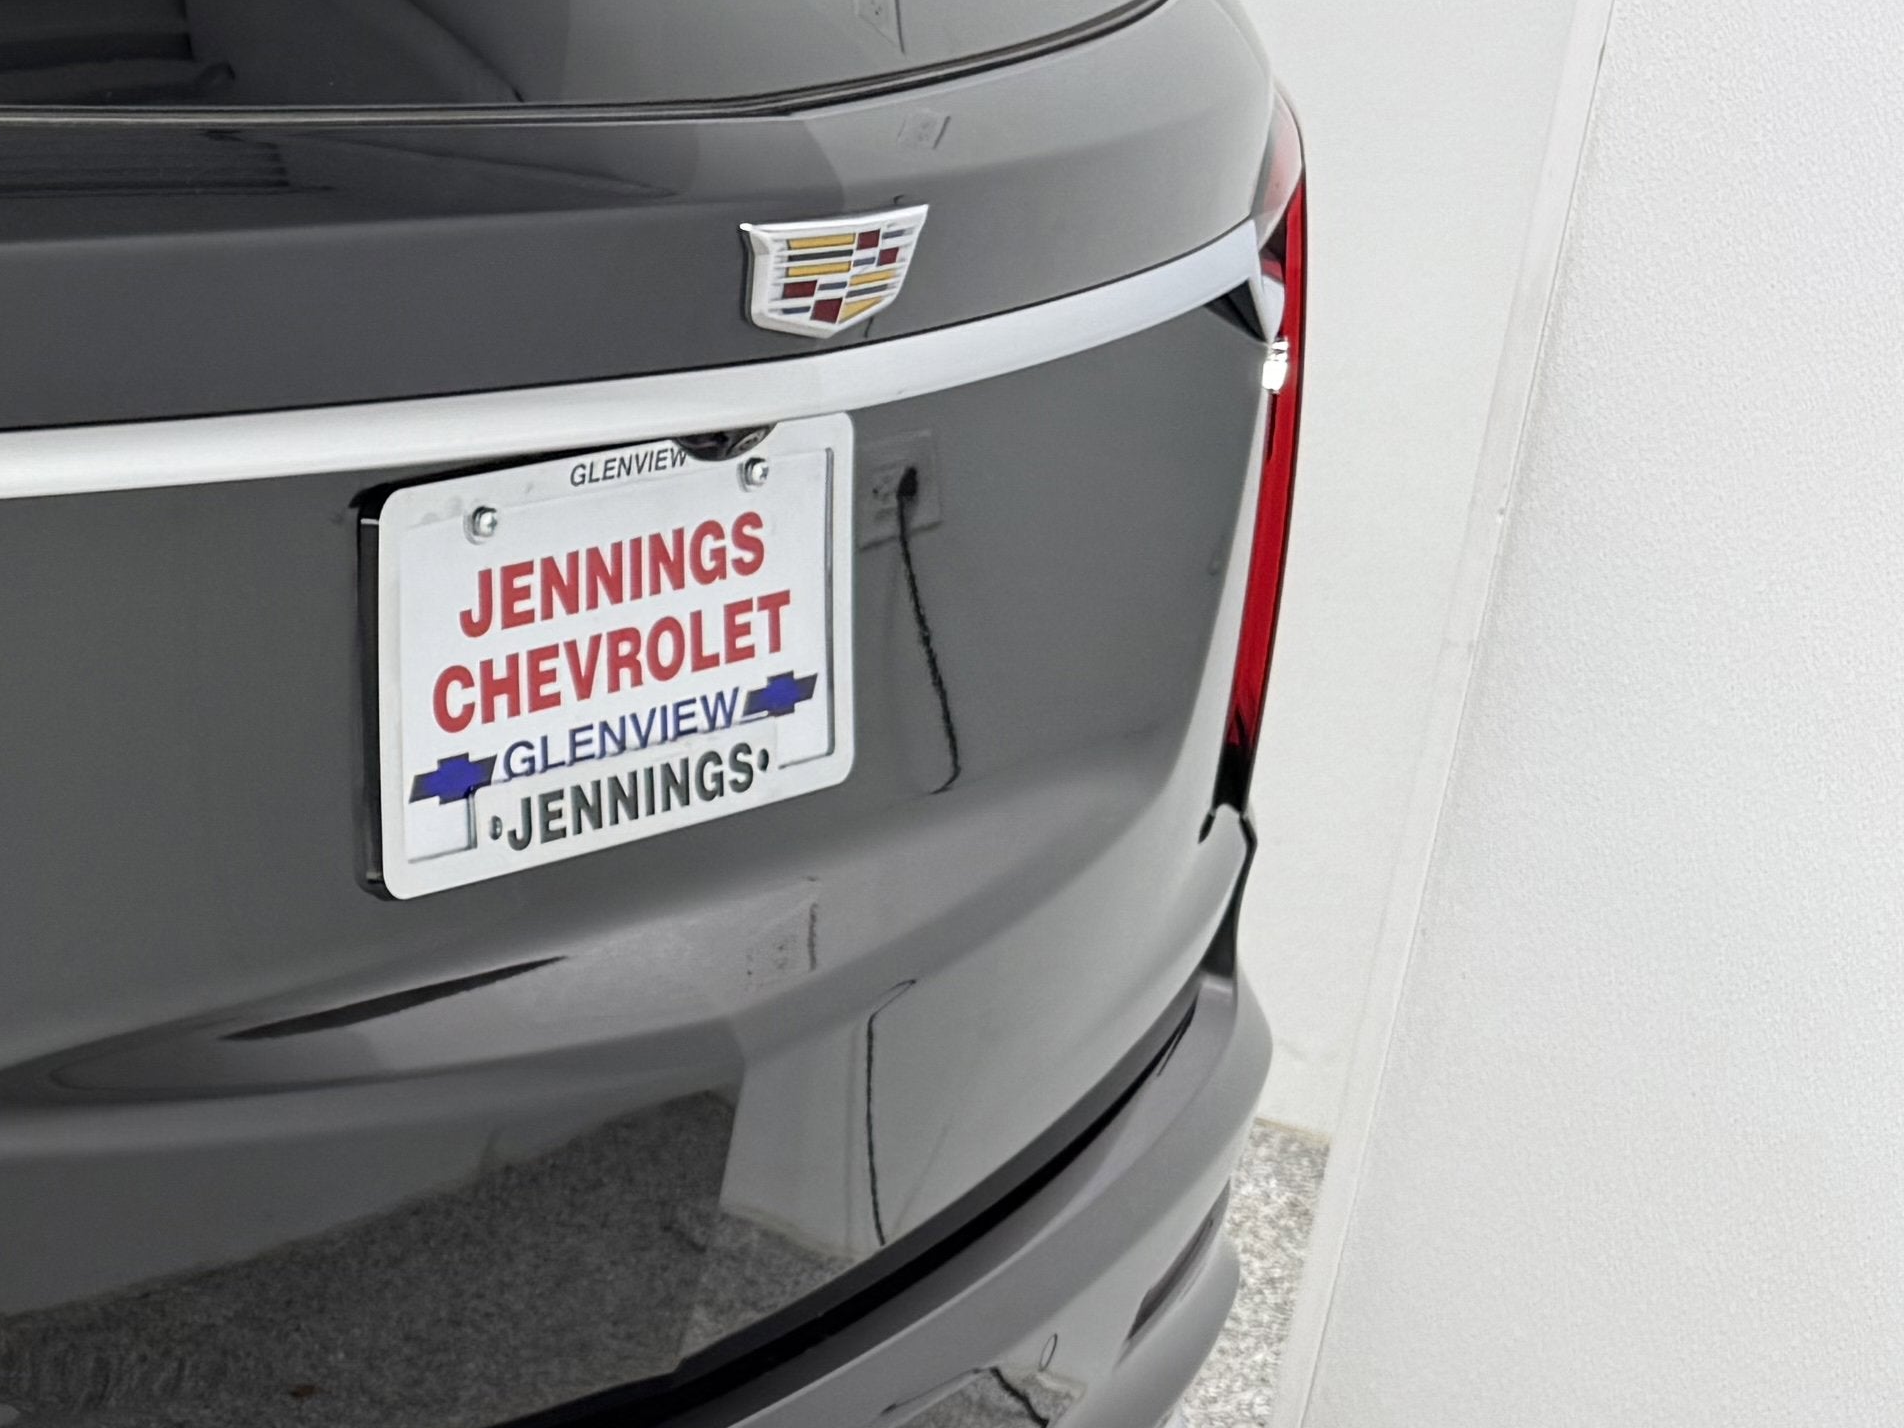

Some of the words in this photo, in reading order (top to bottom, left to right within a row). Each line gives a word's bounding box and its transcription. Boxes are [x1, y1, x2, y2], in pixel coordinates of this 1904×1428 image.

[570, 447, 687, 487] GLENVIEW
[459, 511, 765, 638] JENNINGS
[432, 589, 791, 734] CHEVROLET
[502, 686, 741, 782] GLENVIEW
[506, 741, 754, 851] JENNINGS
